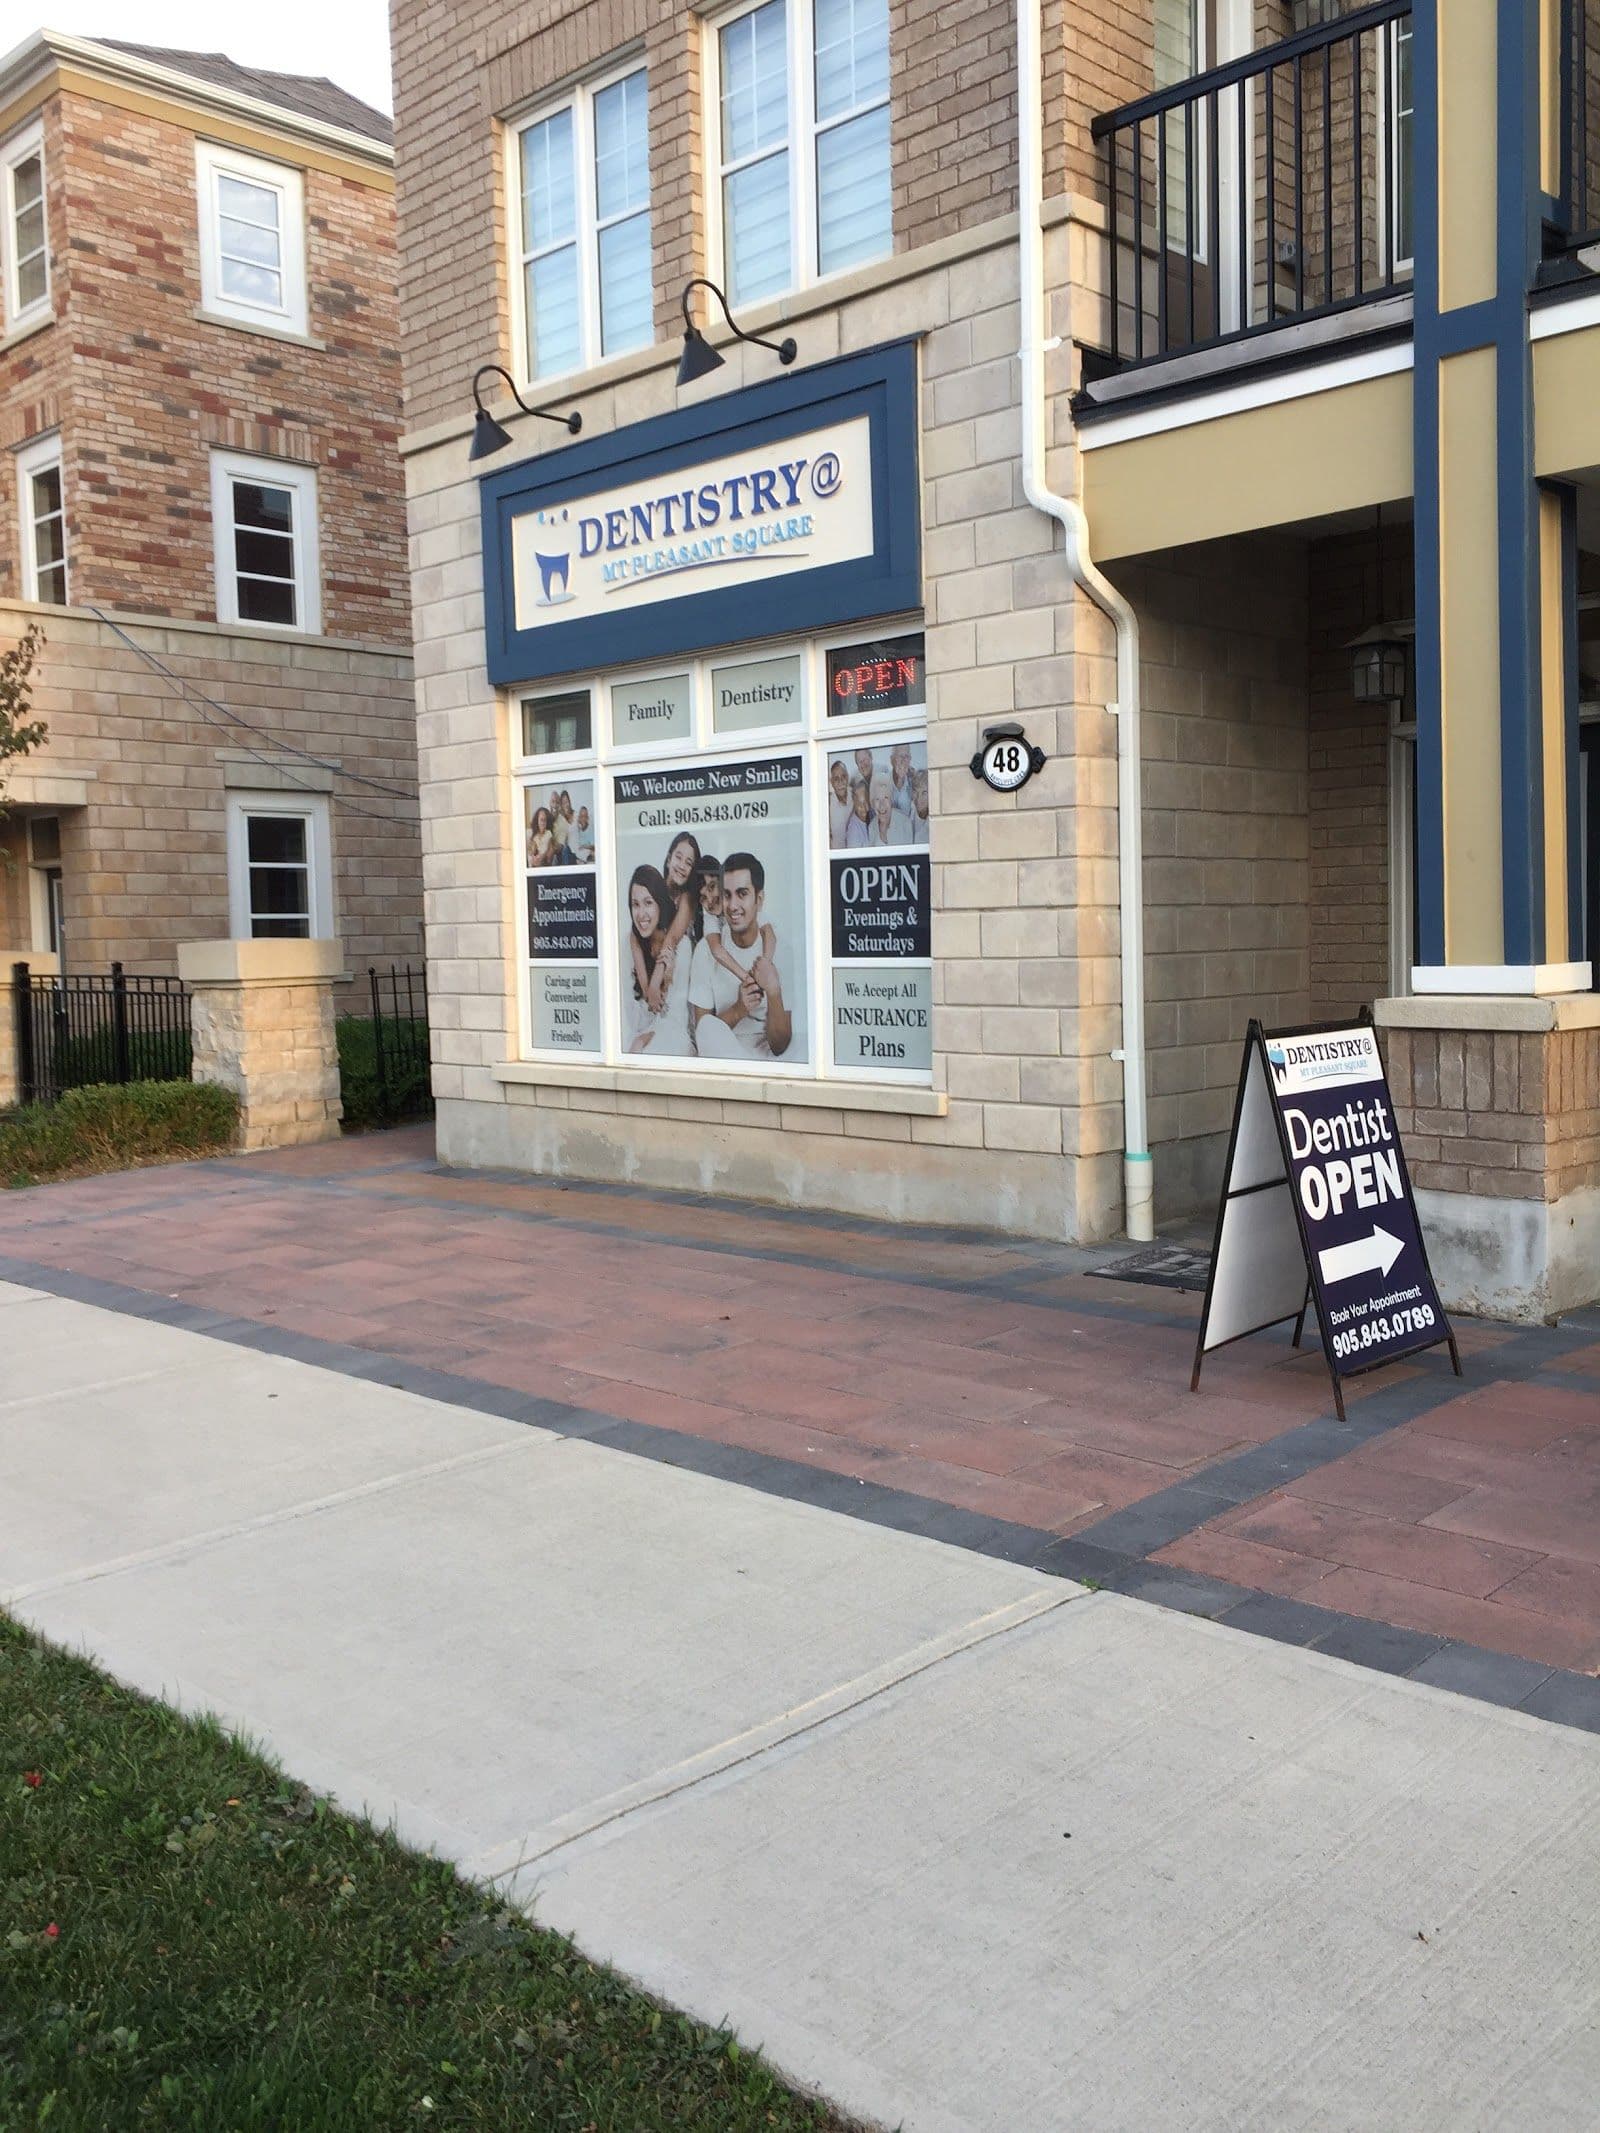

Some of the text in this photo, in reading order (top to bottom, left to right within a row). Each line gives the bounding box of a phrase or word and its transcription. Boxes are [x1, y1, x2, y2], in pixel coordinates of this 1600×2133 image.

[578, 452, 842, 558] DENTISTRY@
[602, 515, 814, 583] MT PLEASANT SQUARE
[834, 657, 916, 698] OPEN
[721, 682, 795, 708] Dentistry
[628, 700, 675, 721] Family
[993, 746, 1020, 773] 48
[620, 765, 799, 797] We Welcome New Smiles
[638, 801, 769, 828] Call: 905.843.0789
[537, 884, 587, 902] Emergency
[840, 865, 920, 903] OPEN
[532, 906, 595, 926] Appointments
[844, 906, 918, 930] Evenings &
[533, 936, 594, 949] 905.843.0789
[848, 933, 915, 955] Saturdays
[545, 975, 586, 988] Caring and
[845, 983, 917, 1000] We Accept All
[545, 991, 587, 1003] Convenient
[554, 1009, 580, 1024] KIDS
[838, 1008, 927, 1027] INSURANCE
[551, 1029, 583, 1045] Friendly
[859, 1035, 905, 1058] Plans
[1286, 1038, 1373, 1065] DENTISTRY@
[1311, 1063, 1343, 1075] PLEASANT
[1284, 1098, 1393, 1160] Dentist
[1300, 1149, 1404, 1221] OPEN
[1330, 1285, 1422, 1325] Book Your Appointment
[1332, 1303, 1436, 1358] 905.843.0789
